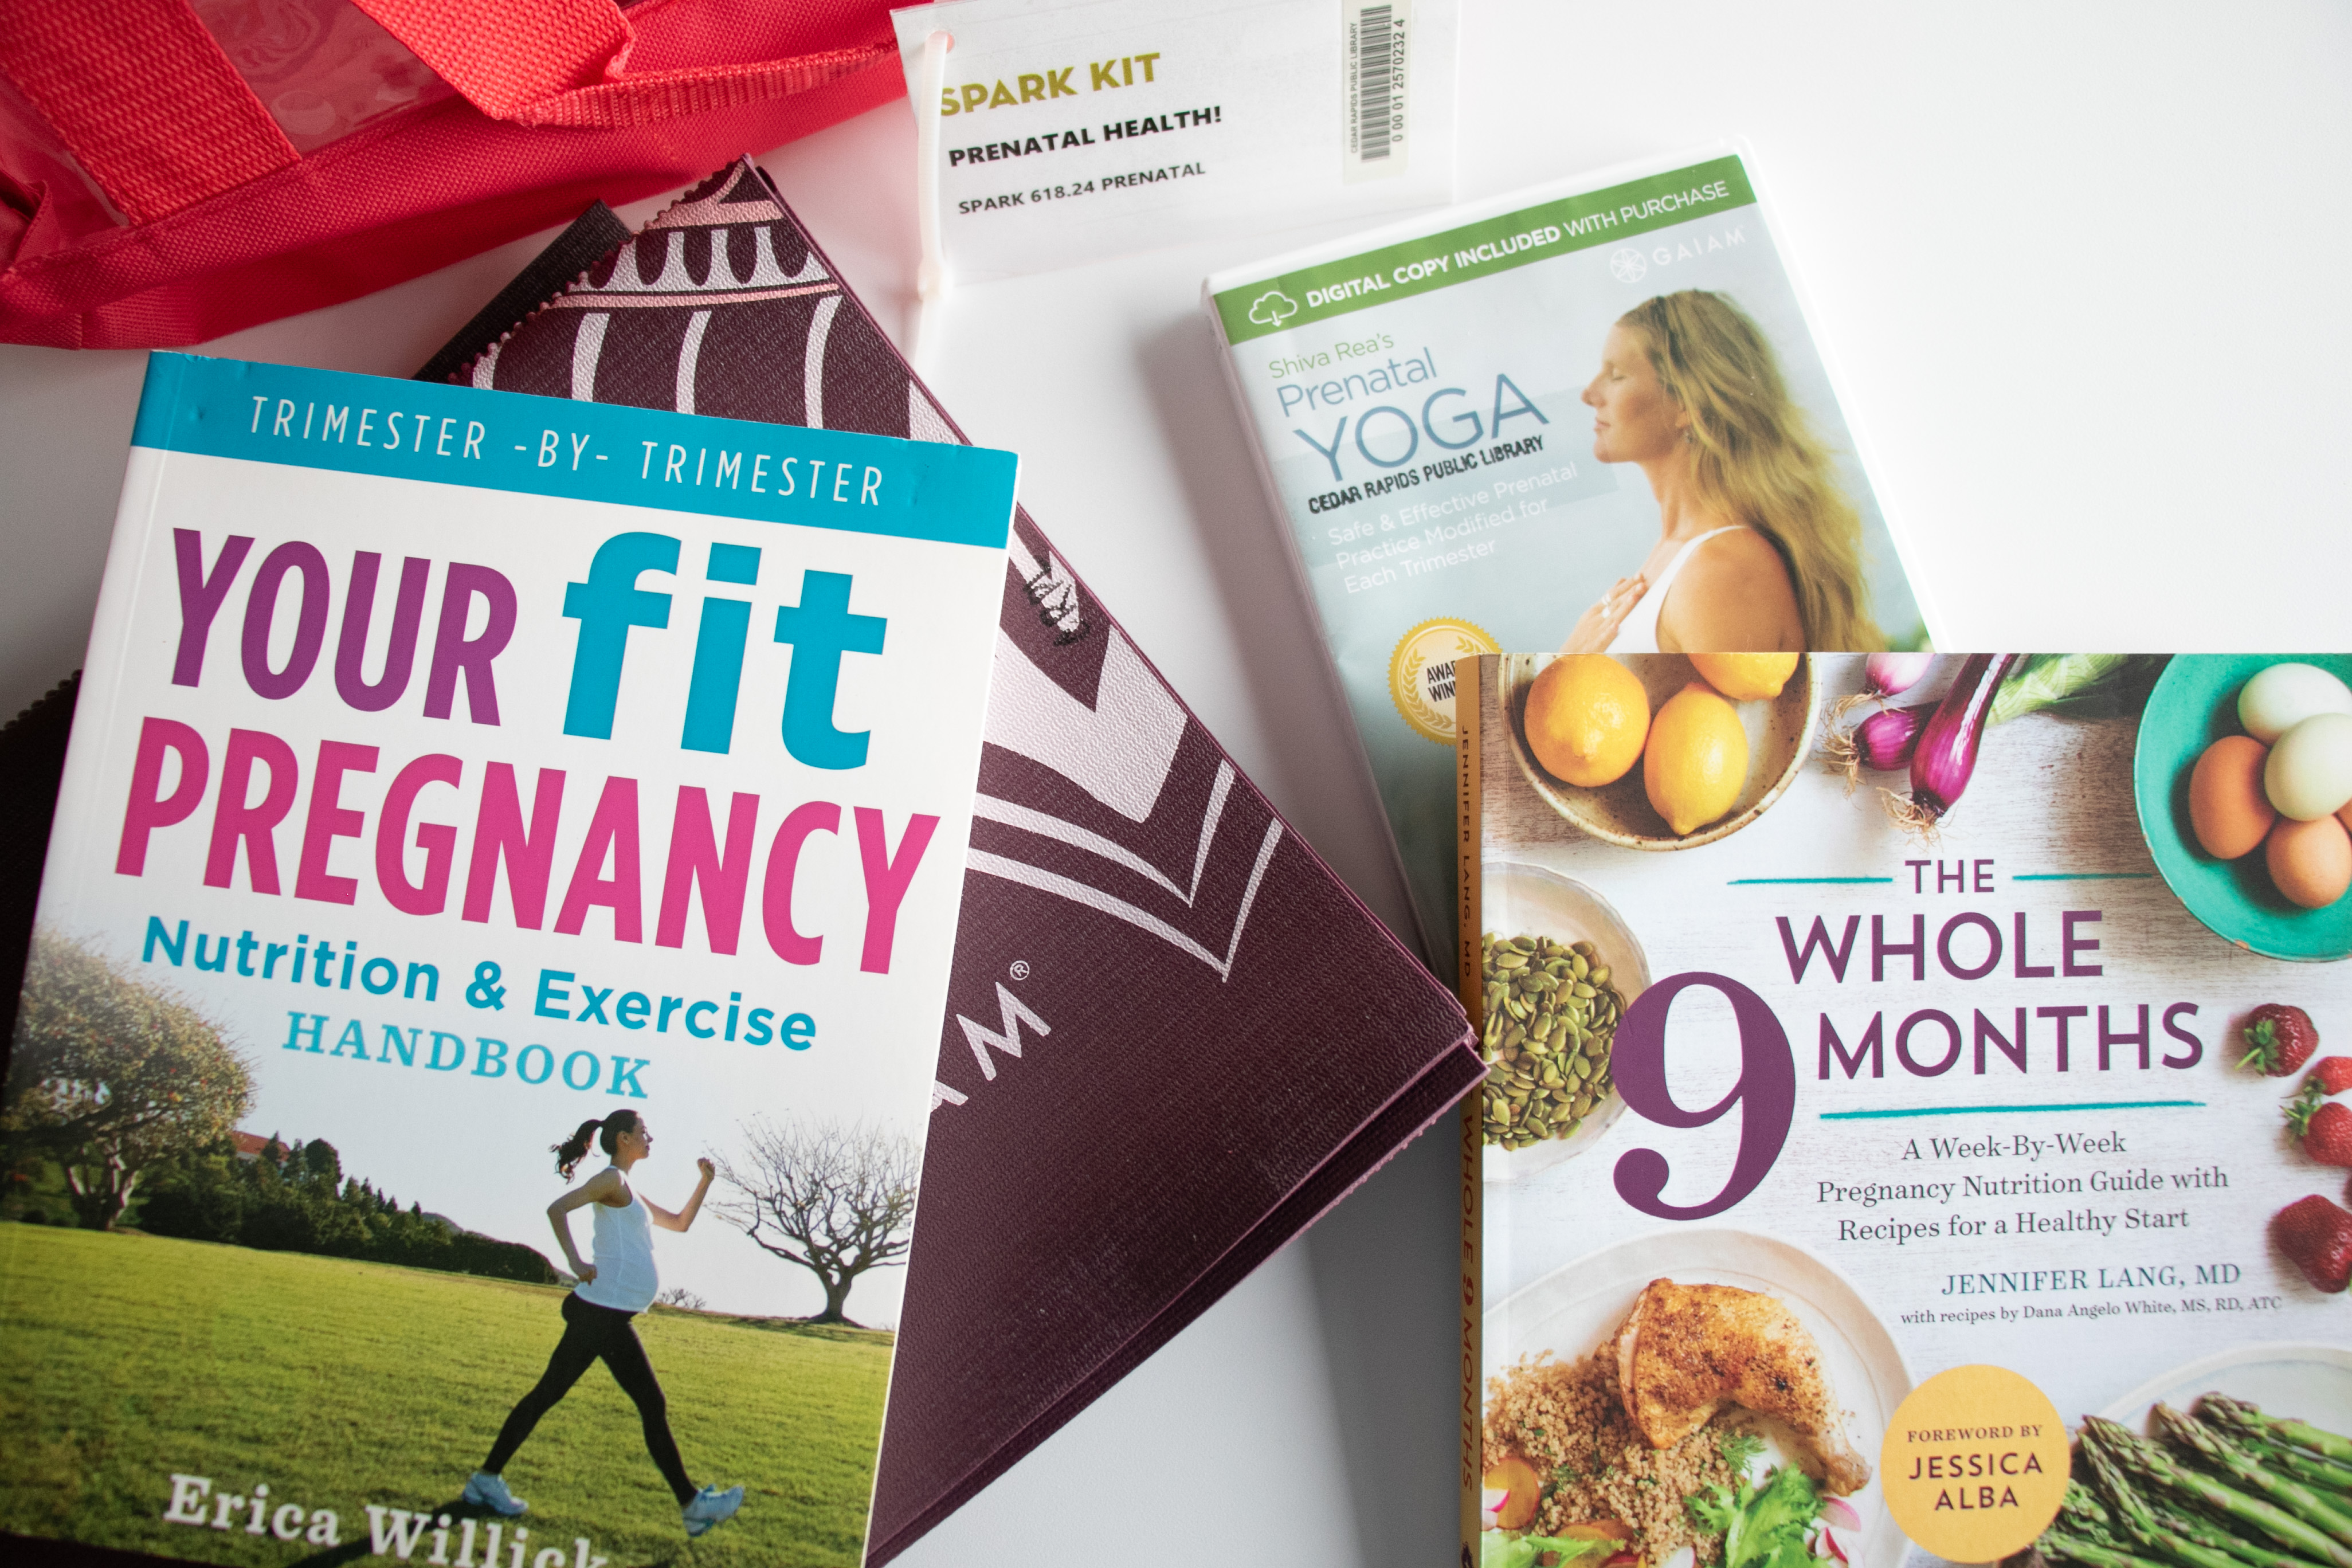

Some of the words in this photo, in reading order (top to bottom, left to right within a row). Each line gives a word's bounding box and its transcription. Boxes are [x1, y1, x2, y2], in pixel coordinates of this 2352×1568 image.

[1349, 22, 1358, 58] LIBRARY
[941, 66, 1078, 116] SPARK
[1091, 52, 1161, 92] KIT
[1350, 61, 1358, 92] PUBLIC
[948, 128, 1096, 167] PRENATAL
[1103, 105, 1223, 142] HEALTH!
[1350, 93, 1358, 124] RAPIDS
[958, 191, 1025, 215] SPARK
[1030, 180, 1096, 203] 618.24
[1101, 162, 1206, 191] PRENATAL
[1306, 273, 1391, 308] DIGITAL
[1393, 255, 1450, 286] COPY
[1455, 225, 1561, 268] INCLUDED
[1563, 210, 1619, 238] WITH
[1621, 180, 1730, 224] PURCHASE
[1652, 228, 1745, 265] GAIAM
[1269, 350, 1331, 379] Shiva
[1335, 334, 1395, 360] Rea's
[1276, 347, 1437, 417] Prenatal
[250, 395, 486, 460] TRIMESTER
[641, 440, 883, 507] TRIMESTER
[1292, 373, 1550, 482] YOGA
[1308, 487, 1362, 514] CEDAR
[1364, 471, 1420, 500] RAPIDS
[1424, 454, 1478, 482] PUBLIC
[1479, 434, 1546, 467] LIBRARY
[1328, 519, 1374, 546] Safe
[1379, 515, 1396, 532] &
[1399, 489, 1490, 527] Effective
[1493, 462, 1578, 500] Prenatal
[1336, 535, 1421, 570] Practice
[1425, 510, 1515, 546] Modified
[1519, 499, 1549, 519] for
[1344, 569, 1396, 594] Each
[1400, 540, 1496, 578] Trimester
[172, 527, 518, 726] YOUR
[562, 531, 888, 771] fit
[1461, 725, 1471, 844] JENNIFER
[115, 716, 941, 975] PREGNANCY
[1905, 859, 1996, 895] THE
[1464, 940, 1471, 977] MD
[1775, 910, 2103, 985] WHOLE
[142, 915, 440, 1002] Nutrition
[465, 961, 508, 1012] &
[534, 969, 817, 1052] Exercise
[281, 1011, 652, 1099] HANDBOOK
[1817, 1002, 2204, 1080] MONTHS
[1610, 971, 1796, 1221] 9
[1900, 1138, 1922, 1161] A
[1930, 1131, 2127, 1162] Week-By-Week
[1463, 1115, 1473, 1264] WHOLE
[1817, 1180, 1955, 1208] Pregnancy
[1962, 1172, 2083, 1197] Nutrition
[2090, 1170, 2164, 1193] Guide
[2170, 1166, 2229, 1189] with
[1837, 1218, 1941, 1245] Recipes
[1948, 1213, 1987, 1237] for
[1994, 1220, 2008, 1235] a
[2016, 1209, 2116, 1236] Healthy
[2124, 1207, 2190, 1229] Start
[1463, 1273, 1474, 1307] 9
[1941, 1268, 2088, 1296] JENNIFER
[2098, 1265, 2186, 1291] LANG,
[2194, 1263, 2241, 1285] MD
[1900, 1310, 1937, 1325] with
[1939, 1307, 1996, 1327] recipes
[2000, 1306, 2019, 1323] by
[2022, 1303, 2063, 1320] Dana
[2067, 1302, 2121, 1322] Angelo
[2125, 1298, 2177, 1318] White,
[2181, 1298, 2210, 1315] MS,
[2216, 1296, 2245, 1312] RD,
[2248, 1296, 2283, 1311] ATC
[1462, 1315, 1473, 1491] MONTHS
[1906, 1425, 2013, 1443] FOREWORD
[2019, 1424, 2043, 1437] BY
[1908, 1451, 2043, 1480] JESSICA
[163, 1473, 341, 1548] Erica
[364, 1503, 609, 1568] Willick
[1934, 1485, 2018, 1511] ALBA
